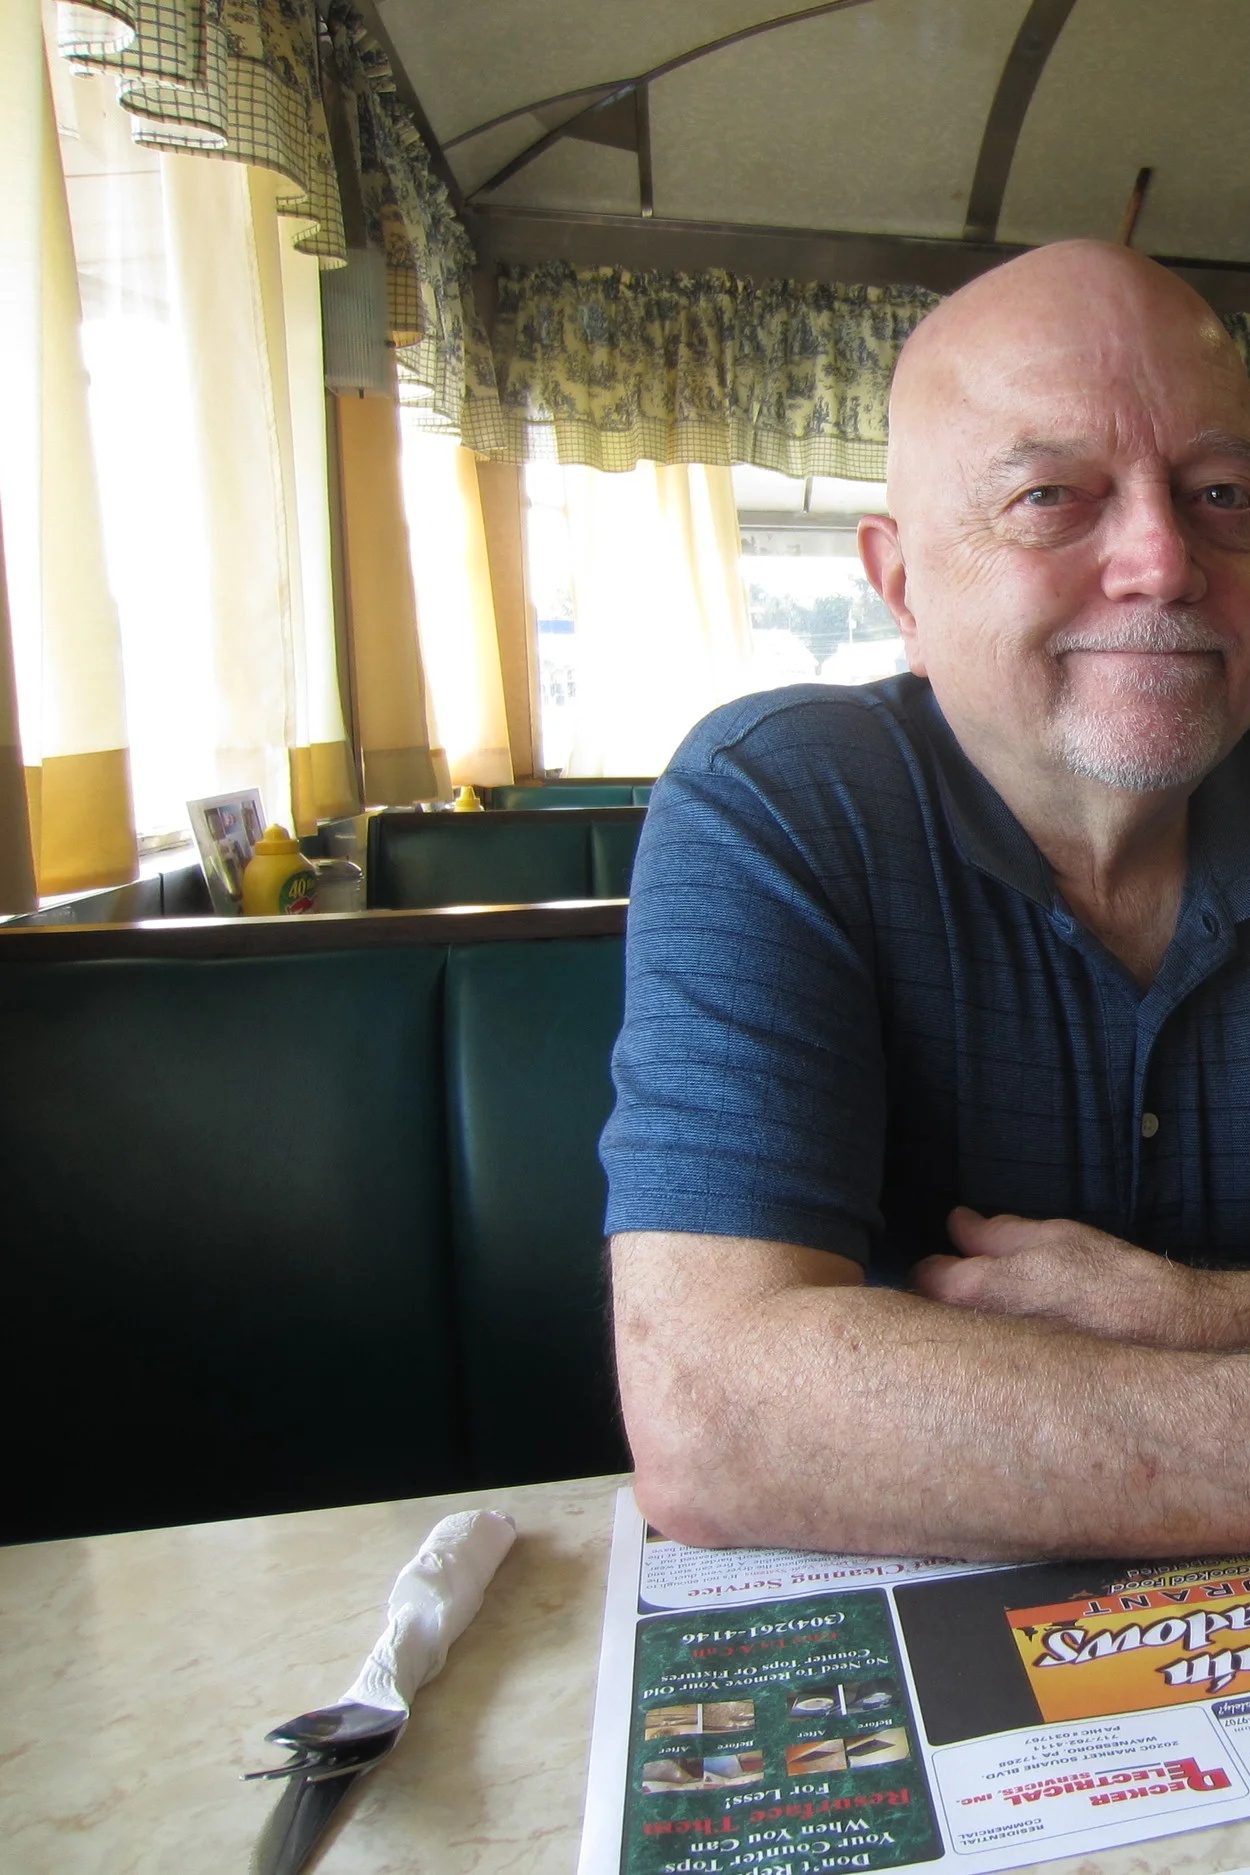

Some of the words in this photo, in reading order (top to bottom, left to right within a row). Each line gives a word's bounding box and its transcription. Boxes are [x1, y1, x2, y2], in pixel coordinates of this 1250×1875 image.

[791, 1564, 904, 1584] Cleaning
[687, 1578, 782, 1597] Service
[1108, 1578, 1165, 1594] Food
[682, 1612, 845, 1645] (304)261-4146
[804, 1648, 871, 1664] Counter
[866, 1656, 888, 1666] No
[734, 1667, 757, 1676] Or
[761, 1658, 800, 1671] Tops
[821, 1660, 861, 1673] Need
[661, 1669, 729, 1683] Fixtures
[725, 1672, 790, 1688] Remove
[795, 1667, 817, 1679] To
[643, 1686, 675, 1699] Old
[680, 1680, 719, 1692] Your
[857, 1719, 893, 1730] Before
[797, 1729, 826, 1738] After
[1024, 1732, 1071, 1745] 031767
[1081, 1728, 1102, 1737] HIC
[659, 1745, 689, 1754] After
[717, 1740, 754, 1751] Before
[1033, 1733, 1119, 1752] 717-762-4111
[1063, 1736, 1157, 1756] WAYNESBORO,
[1139, 1740, 1179, 1751] 2020C
[1042, 1750, 1059, 1758] PA
[1082, 1747, 1136, 1760] MARKET
[998, 1755, 1038, 1768] 17268
[1023, 1755, 1078, 1771] SQUARE
[981, 1766, 1019, 1780] BLVD.
[996, 1772, 1092, 1796] SERVICES,
[1003, 1757, 1200, 1805] ELECTRICAL
[1089, 1768, 1232, 1806] DECKER
[789, 1782, 830, 1796] For
[725, 1788, 780, 1809] Less!
[750, 1788, 910, 1822] Resurface
[956, 1793, 993, 1806] INC.
[643, 1816, 740, 1835] Them
[801, 1818, 870, 1834] When
[957, 1818, 1042, 1839] COMMERCIAL
[748, 1828, 792, 1844] You
[838, 1831, 895, 1847] Your
[959, 1824, 1044, 1846] RESIDENTIAL
[690, 1838, 739, 1853] Can
[730, 1841, 830, 1866] Counter
[664, 1859, 723, 1874] Tops
[802, 1853, 870, 1872] Don't
